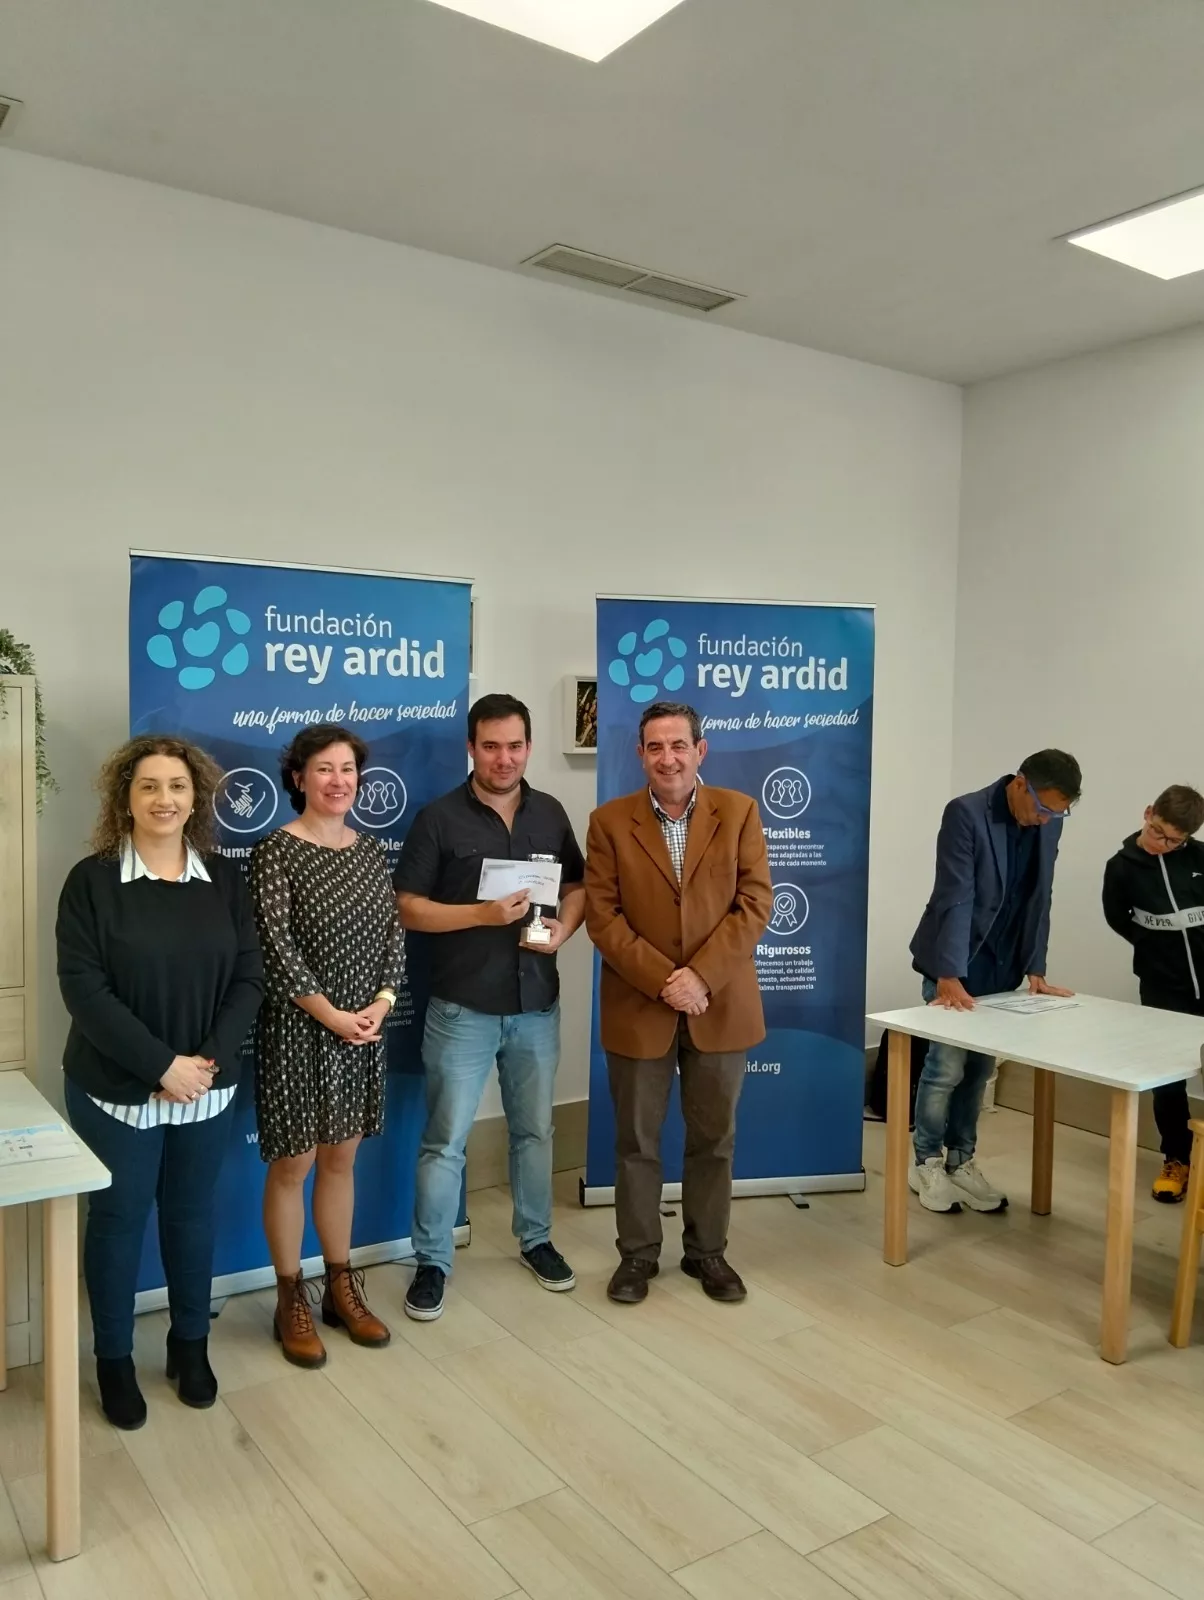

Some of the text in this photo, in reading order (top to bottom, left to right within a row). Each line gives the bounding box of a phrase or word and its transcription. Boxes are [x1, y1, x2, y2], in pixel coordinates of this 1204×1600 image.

[265, 605, 393, 639] fundación
[697, 633, 803, 658] fundación
[265, 638, 445, 685] rey ardid
[697, 656, 848, 698] rey ardid
[233, 699, 457, 735] una forma de hacer sociedad
[744, 713, 761, 729] de
[764, 711, 801, 728] hacer
[803, 709, 859, 727] sociedad
[762, 827, 811, 839] Flexibles
[756, 944, 811, 958] Rigurosos
[775, 983, 814, 991] transparencia
